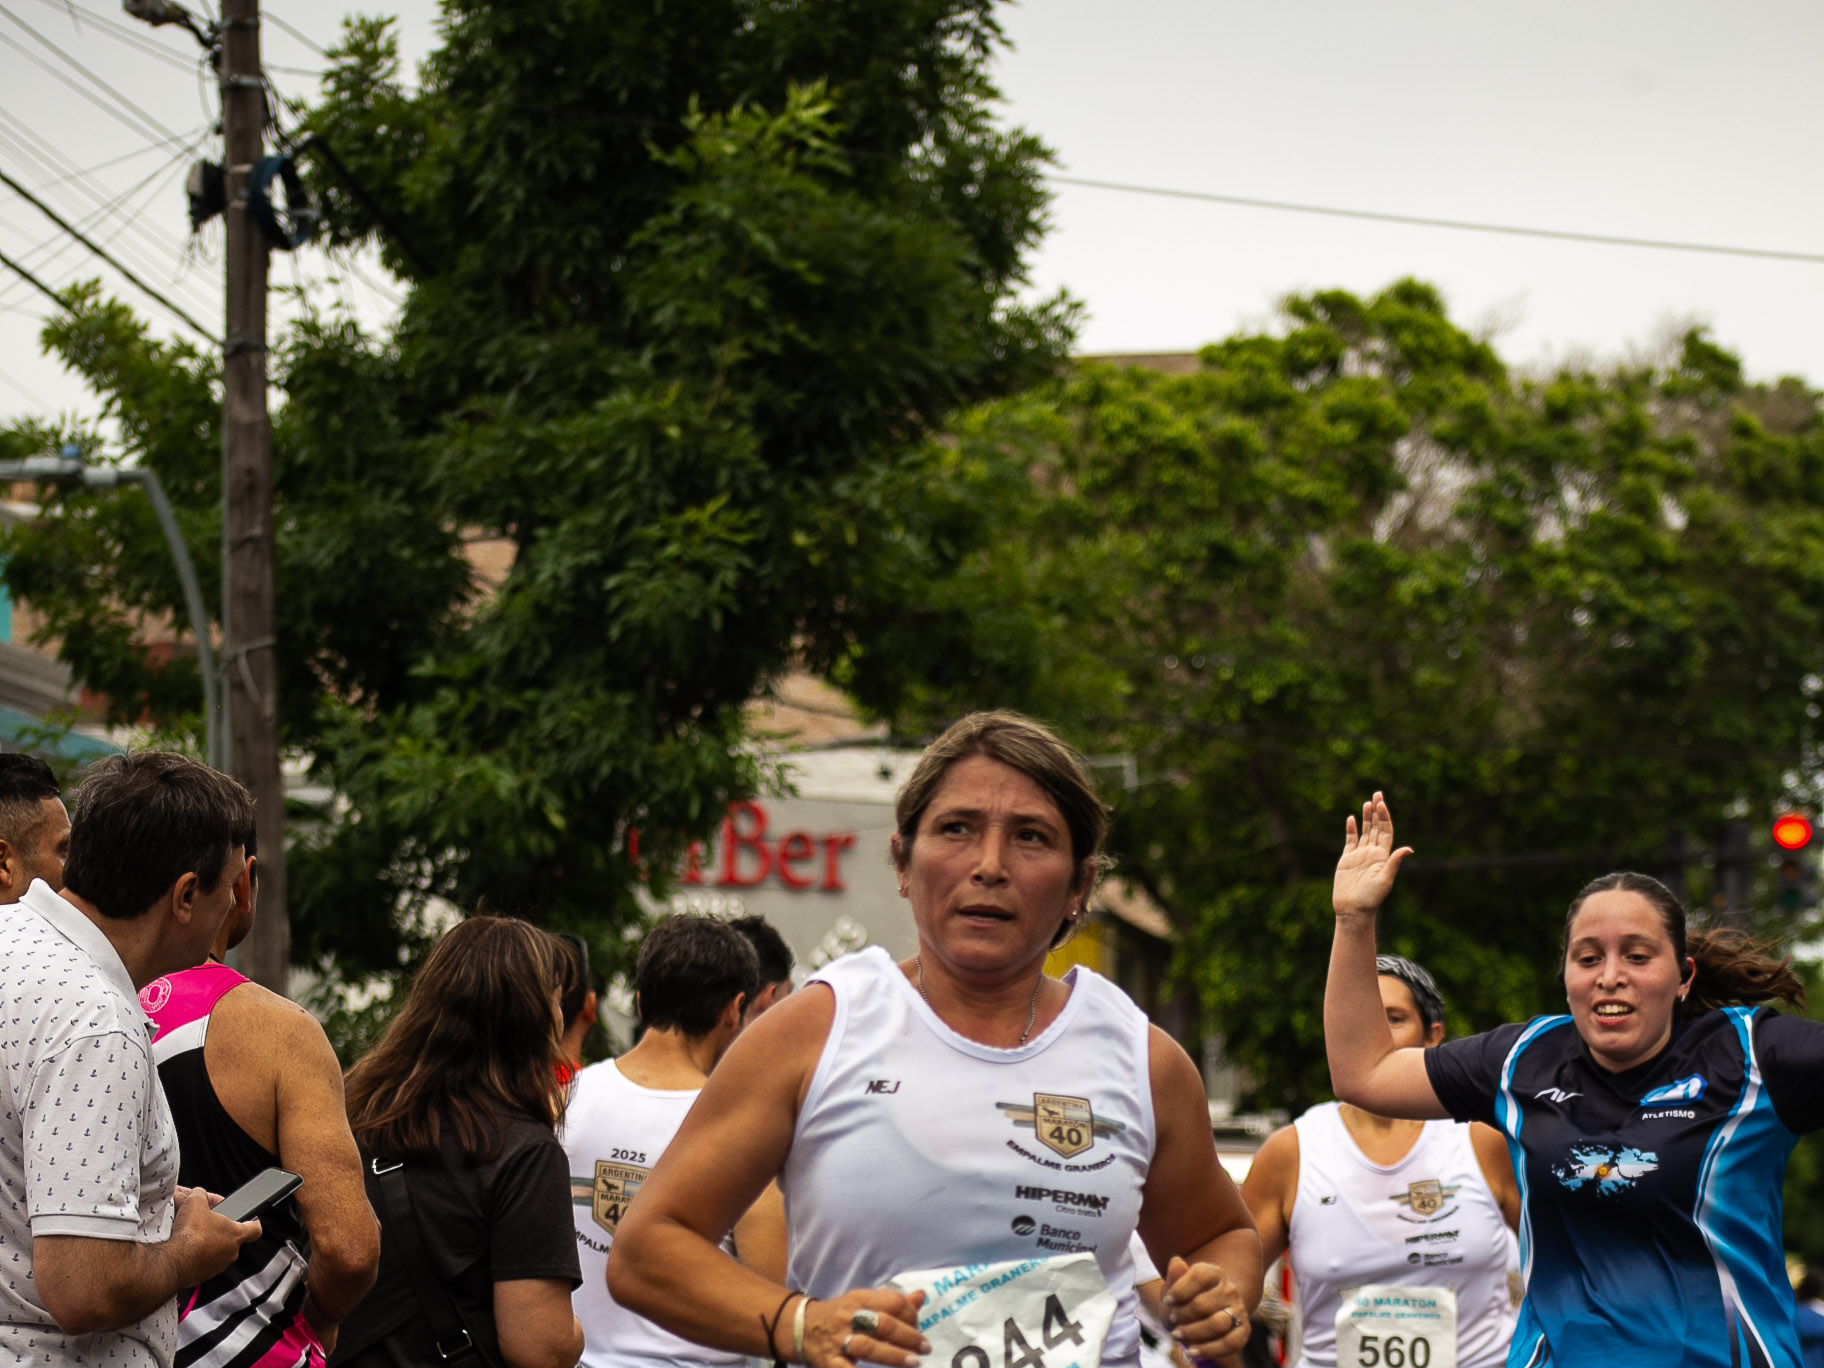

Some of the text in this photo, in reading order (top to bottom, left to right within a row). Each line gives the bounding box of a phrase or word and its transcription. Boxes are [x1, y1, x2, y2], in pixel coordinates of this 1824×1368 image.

[865, 1079, 901, 1095] NEJ
[1641, 1110, 1696, 1121] ATLETISMO
[1049, 1126, 1083, 1146] 40
[611, 1148, 647, 1163] 2025
[1006, 1139, 1062, 1171] EMPALME
[601, 1193, 632, 1204] MARAT
[1041, 1224, 1081, 1241] Banco
[575, 1231, 612, 1255] MPALM
[919, 1289, 978, 1333] MPALME
[1373, 1297, 1437, 1309] MARATON
